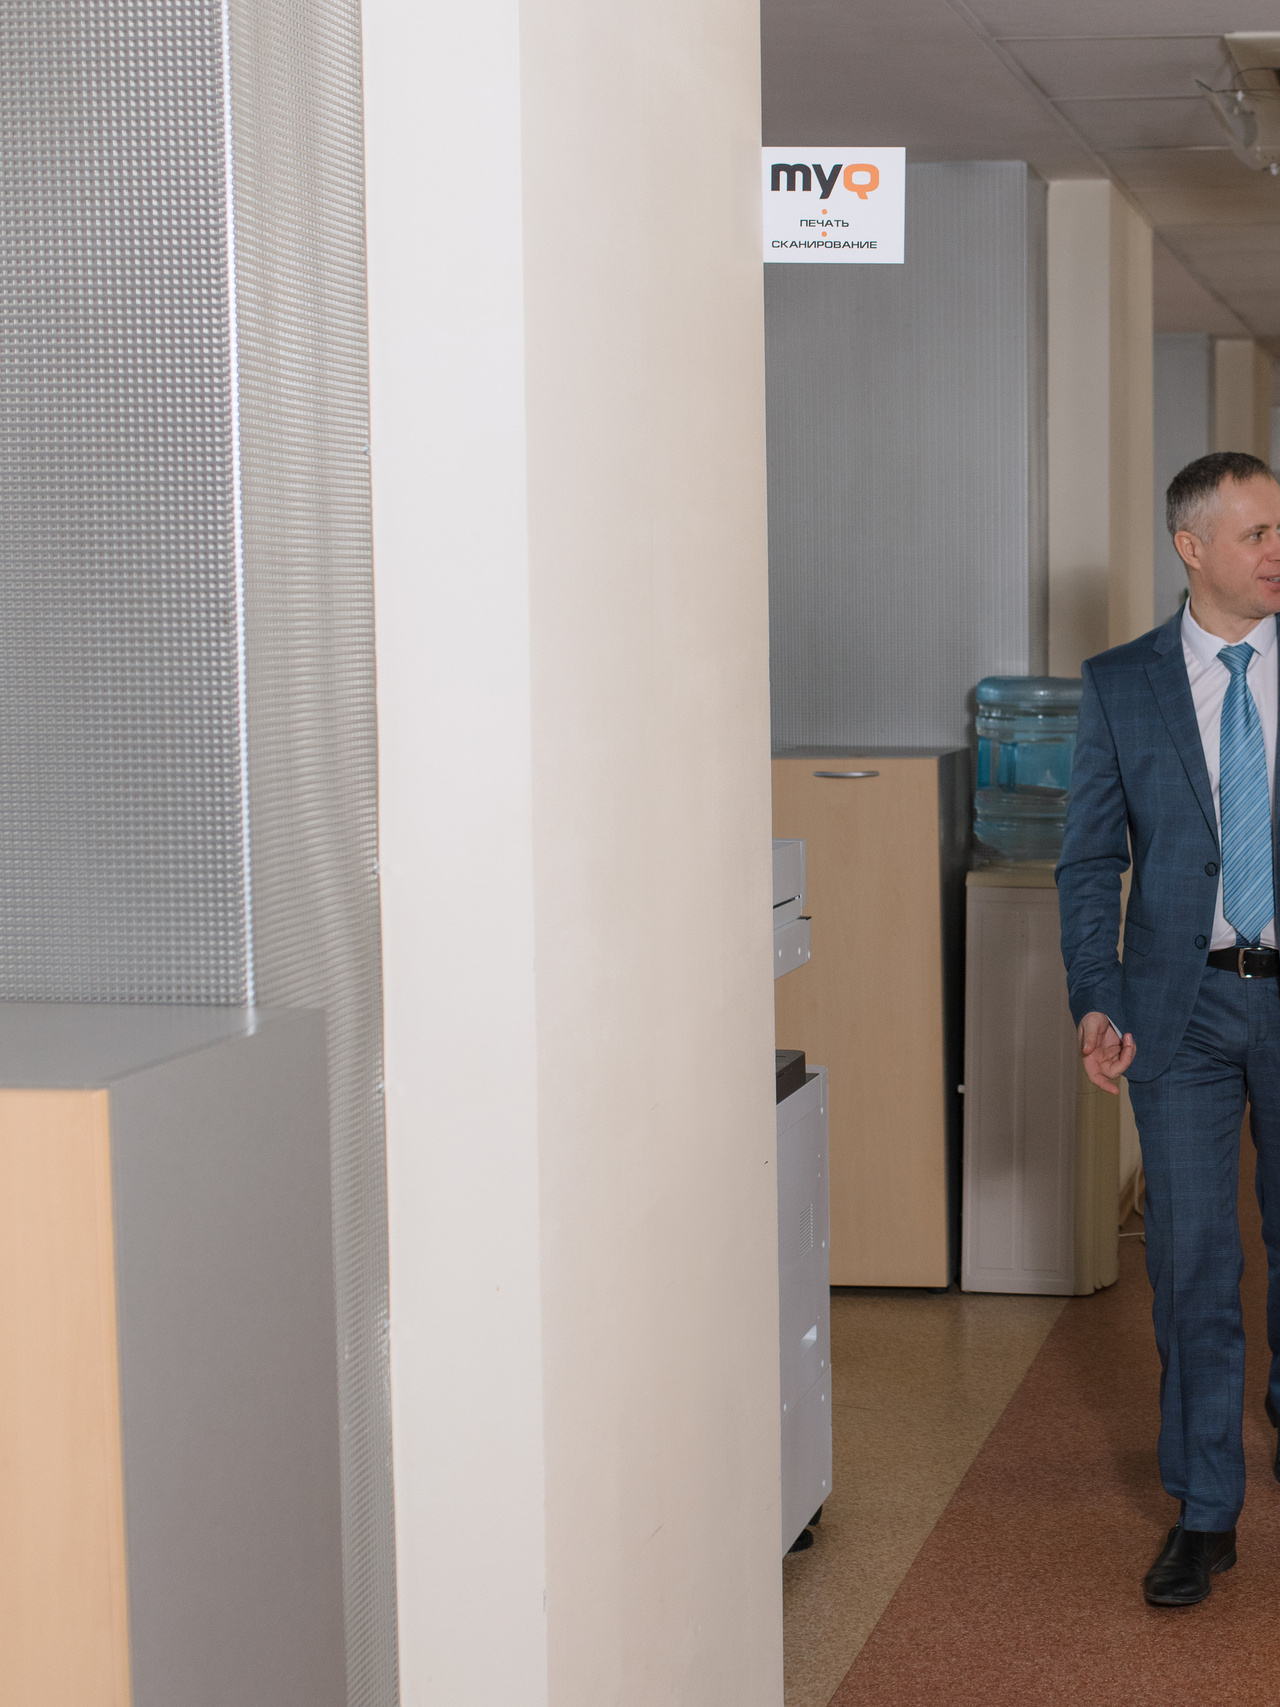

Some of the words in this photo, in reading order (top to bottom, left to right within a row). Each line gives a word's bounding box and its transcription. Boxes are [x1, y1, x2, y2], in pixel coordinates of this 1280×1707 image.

[770, 163, 880, 200] myQ
[799, 219, 850, 228] ПЕЧАТЬ
[771, 240, 878, 249] СКАНИРОВАНИЕ
